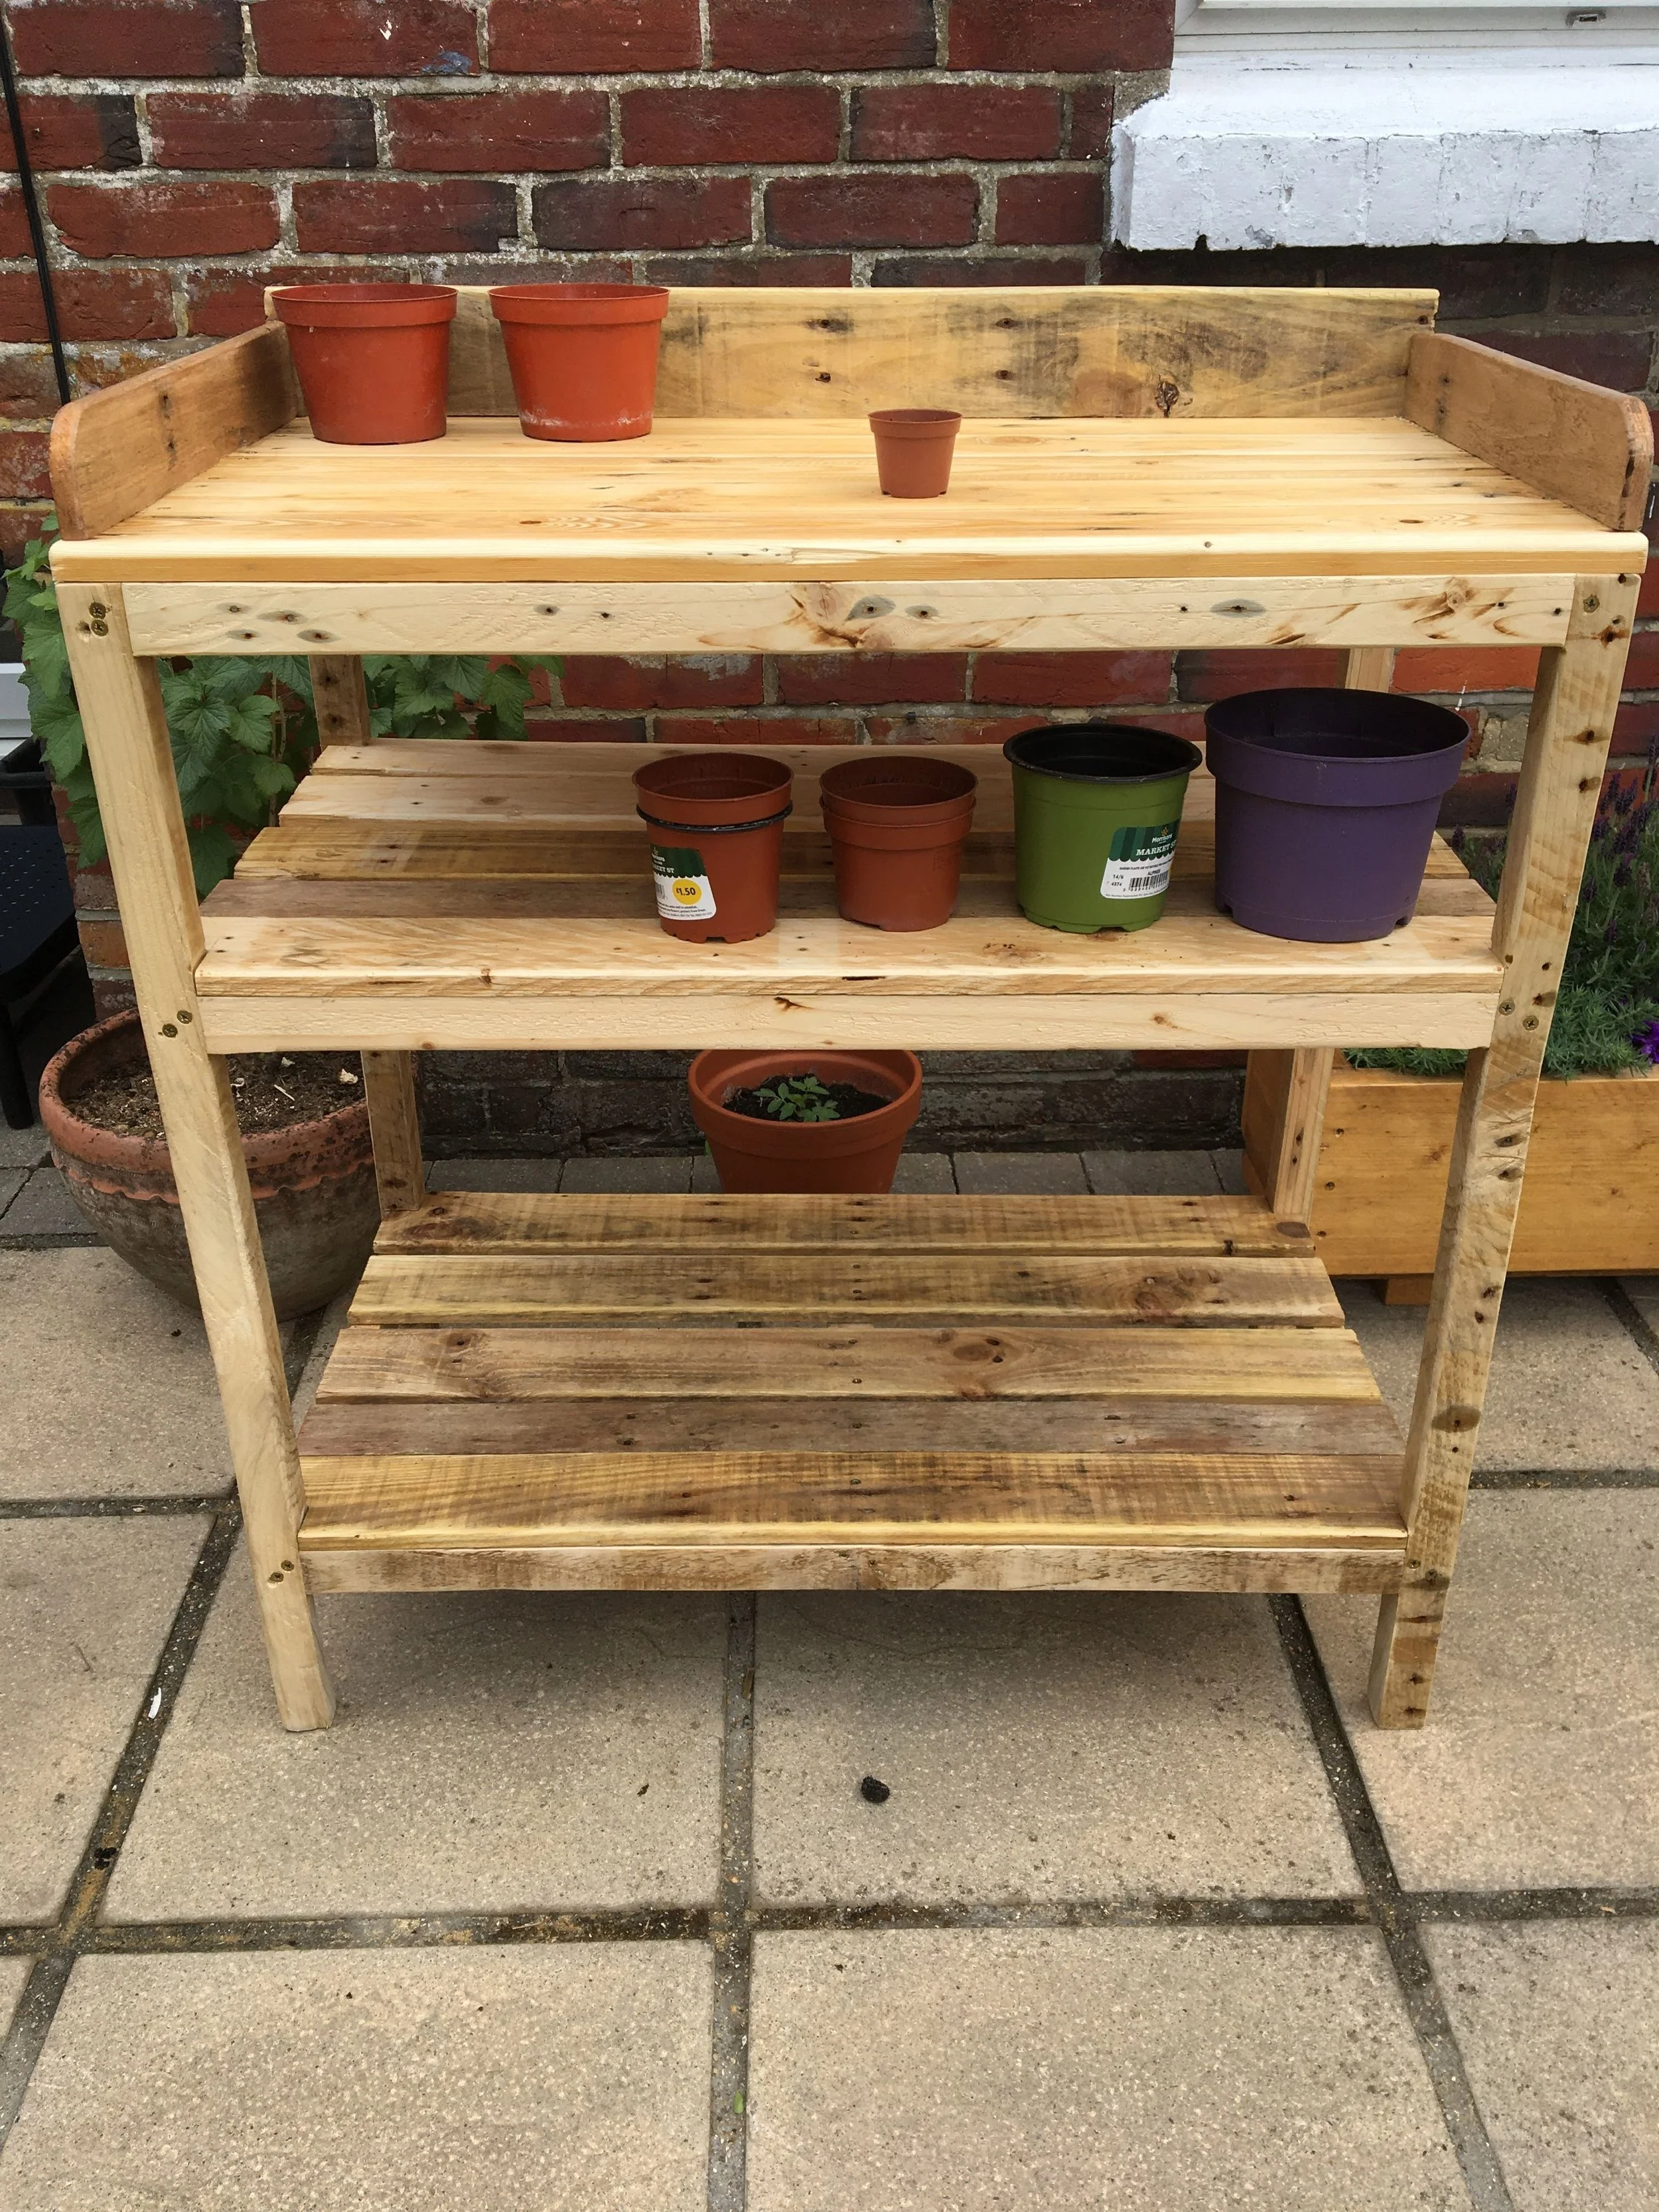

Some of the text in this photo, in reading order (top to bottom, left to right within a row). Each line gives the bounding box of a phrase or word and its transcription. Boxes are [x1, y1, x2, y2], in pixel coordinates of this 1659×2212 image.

[1152, 834, 1173, 843] Morrisons
[1135, 843, 1171, 856] MARKET
[676, 887, 696, 896] £1.50
